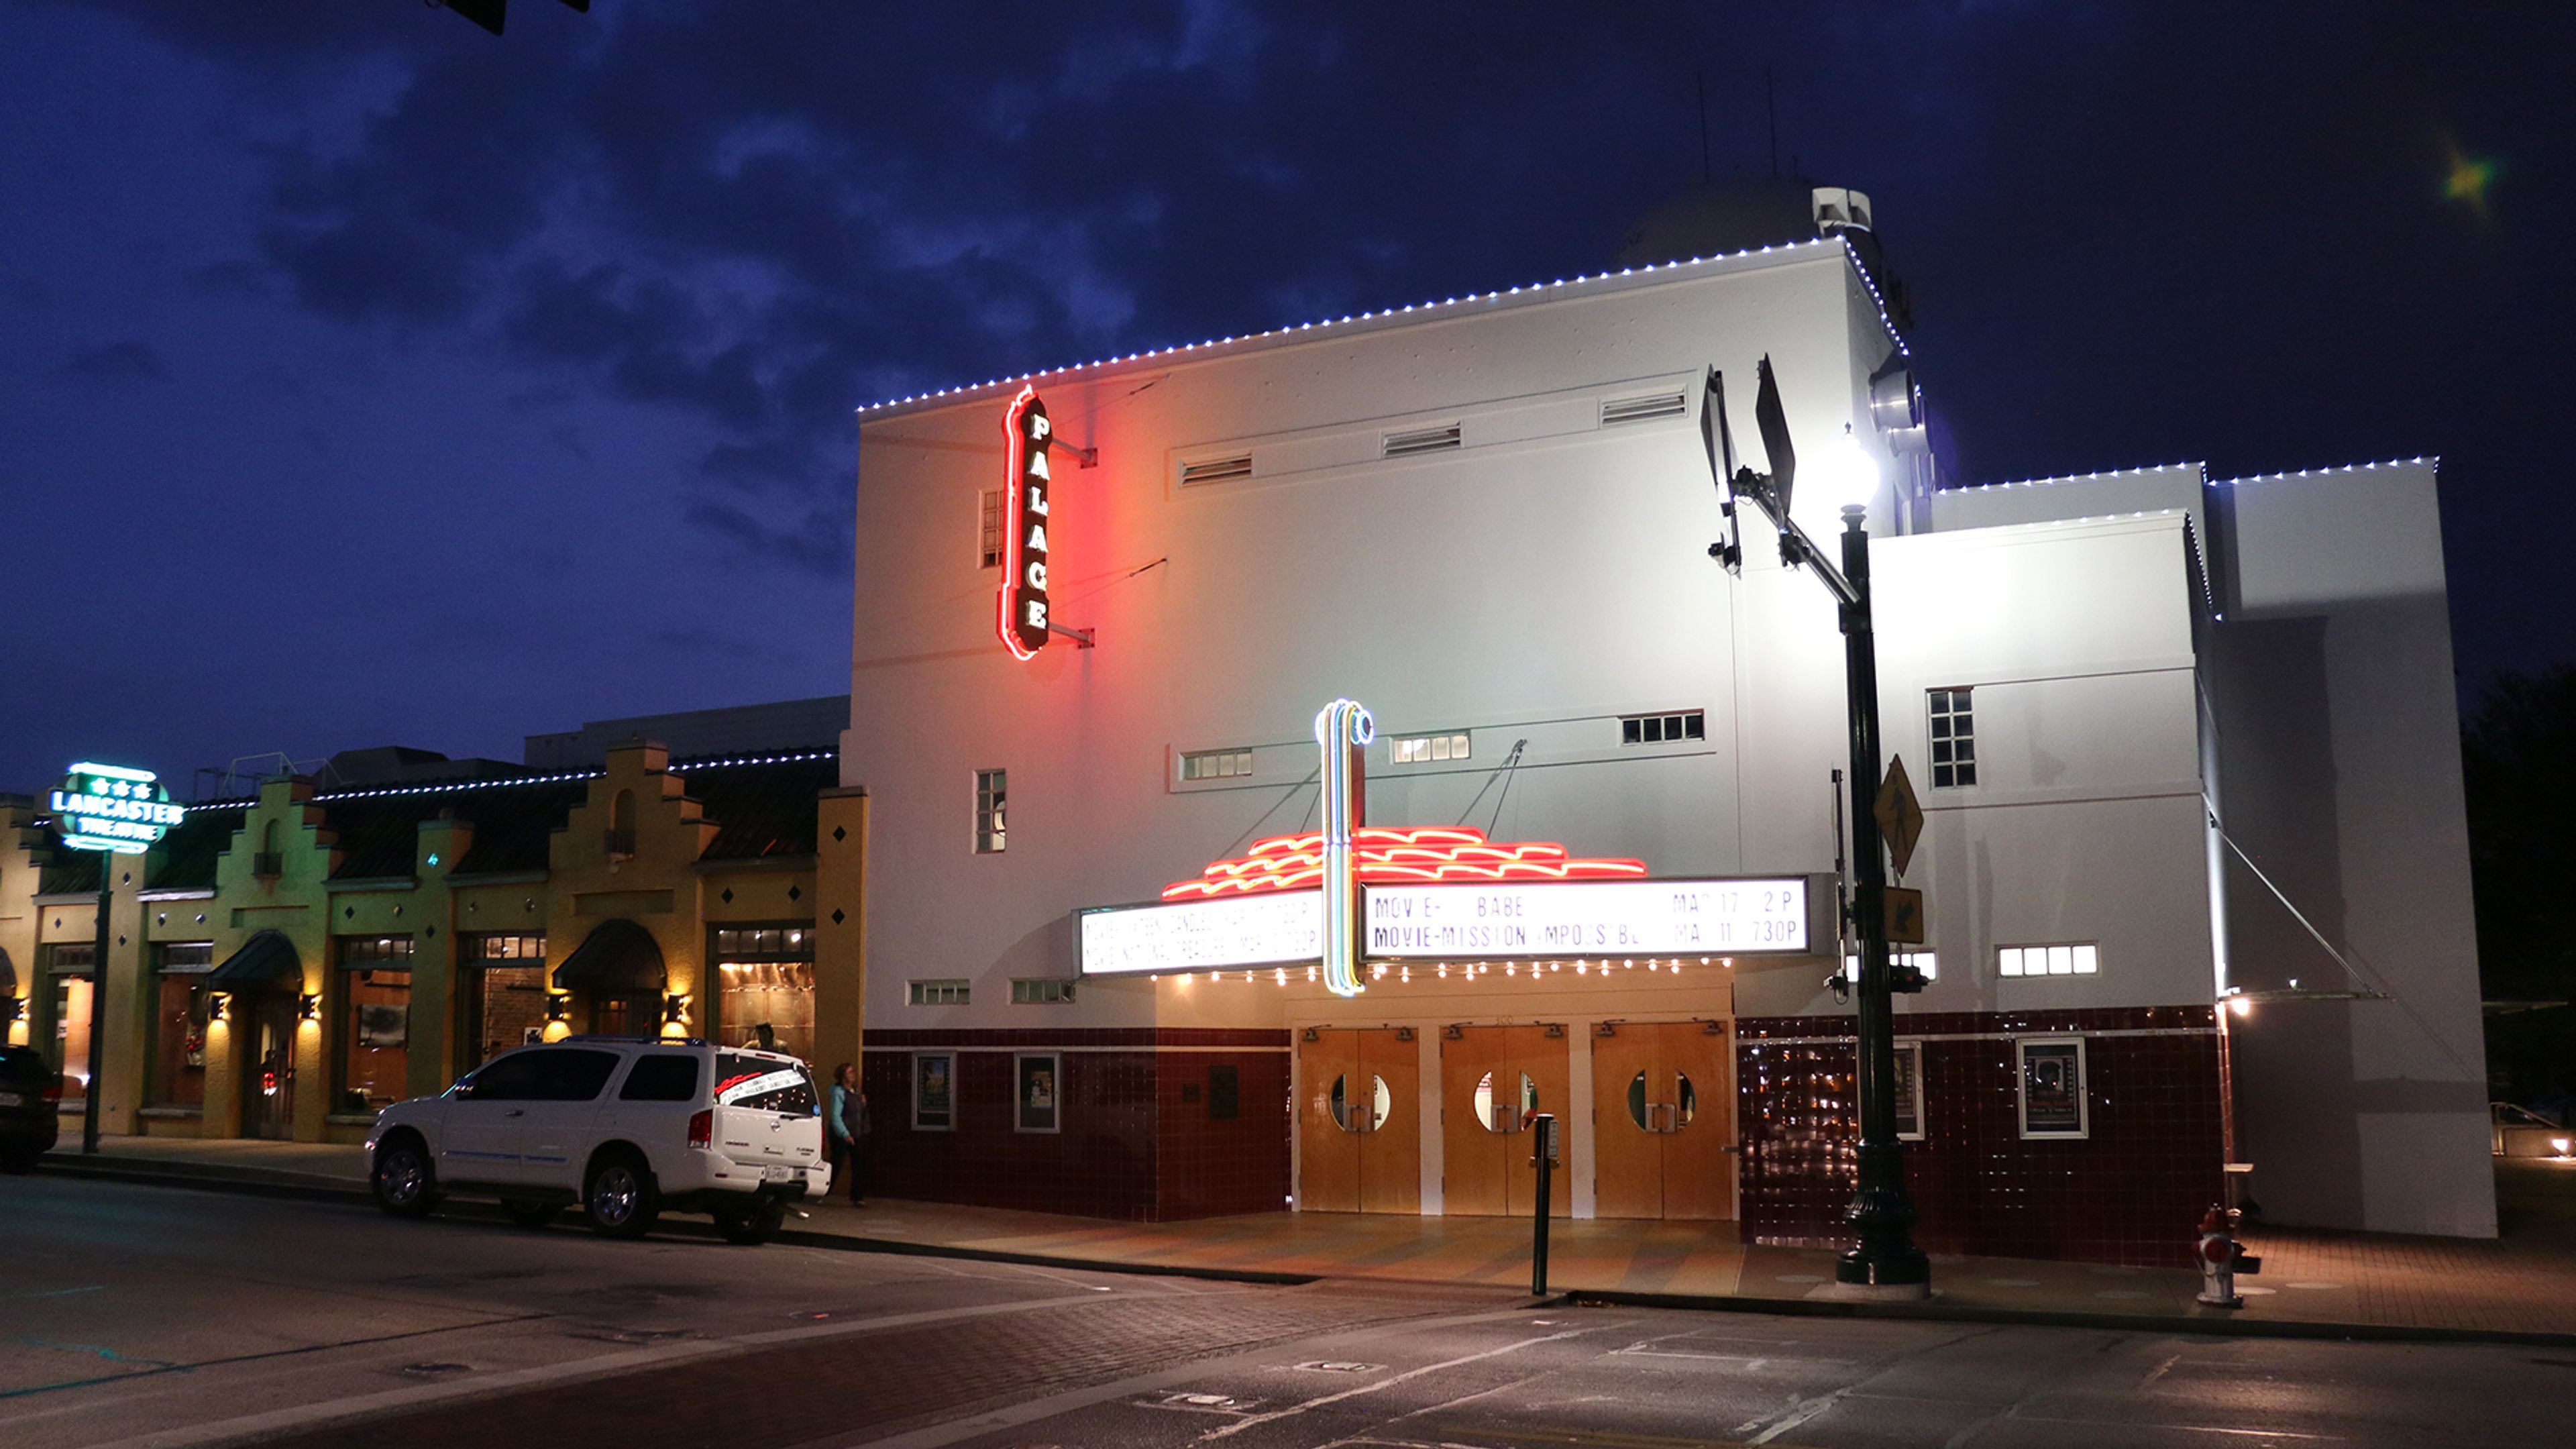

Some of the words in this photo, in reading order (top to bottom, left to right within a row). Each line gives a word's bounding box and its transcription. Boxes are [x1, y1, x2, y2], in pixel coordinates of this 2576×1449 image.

[1025, 413, 1051, 629] PALACE
[52, 792, 184, 825] LANCASTER
[1375, 896, 1441, 918] MOVE-
[1477, 896, 1524, 918] BABE
[1721, 892, 1738, 913] 17
[1720, 922, 1731, 943] 11
[1752, 920, 1796, 942] 730P
